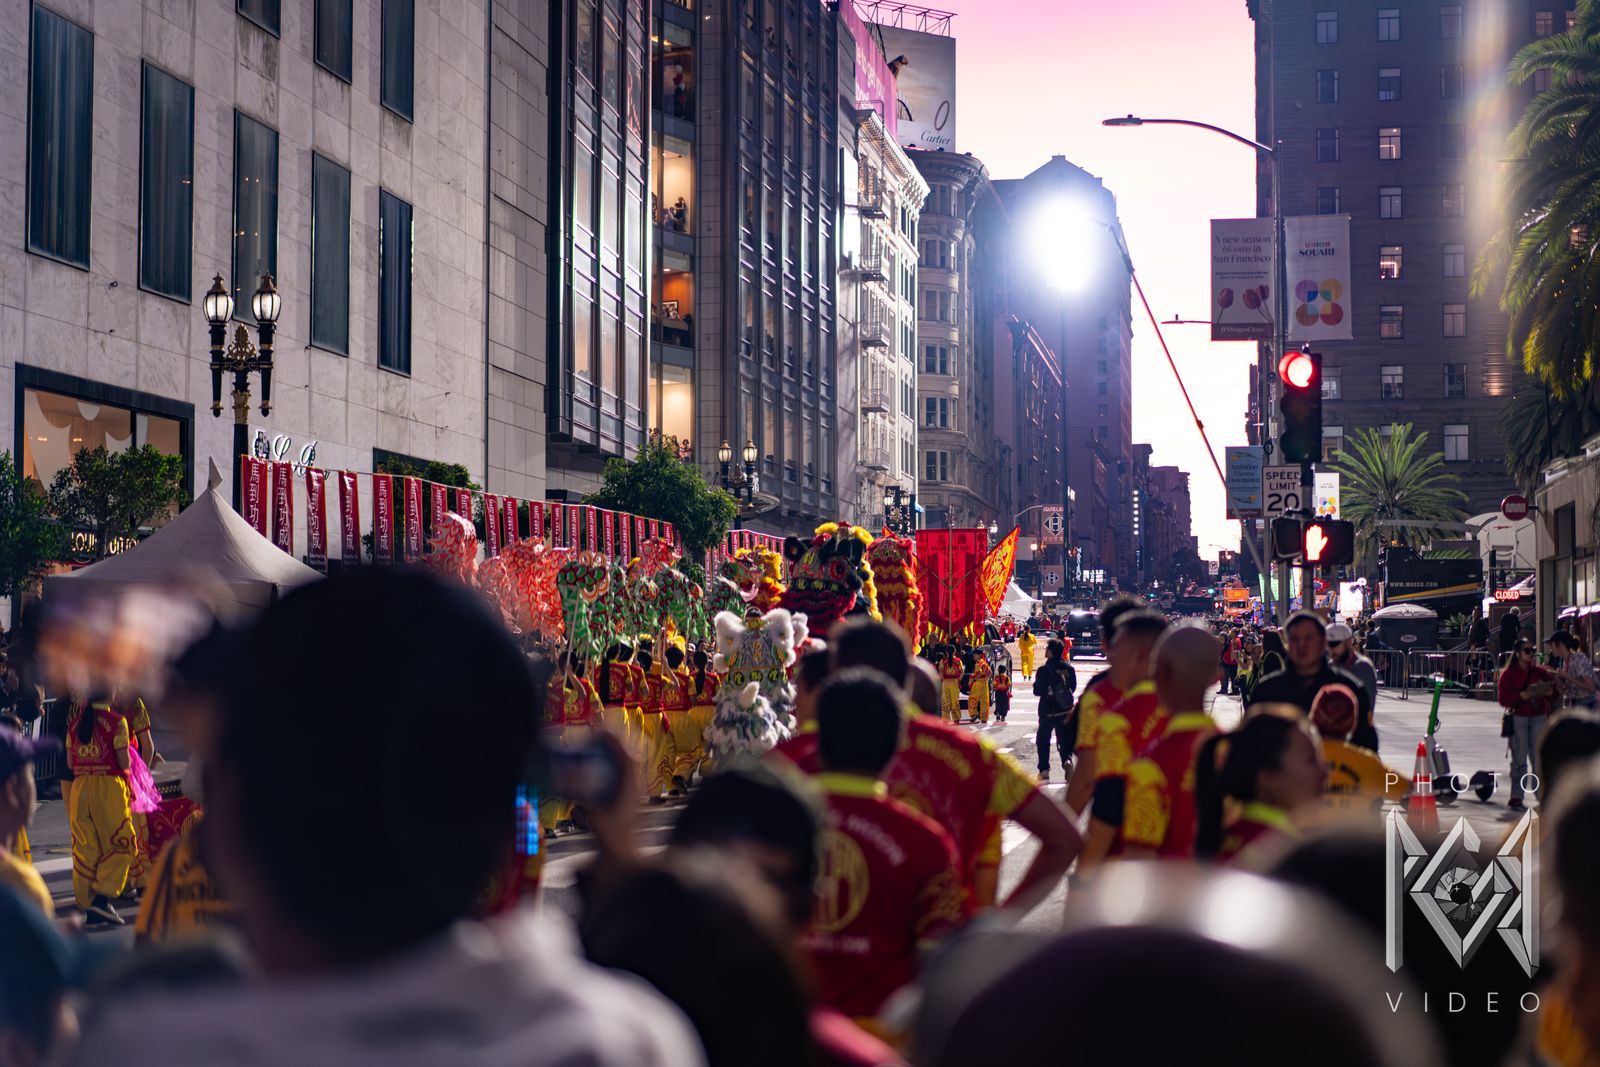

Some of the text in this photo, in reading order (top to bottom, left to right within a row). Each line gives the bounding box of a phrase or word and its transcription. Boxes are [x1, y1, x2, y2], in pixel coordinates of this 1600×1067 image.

[920, 130, 952, 145] Cartier
[1241, 236, 1271, 244] season
[1298, 248, 1336, 257] SQUARE
[1231, 254, 1271, 264] Francisco
[1269, 482, 1297, 491] LIMIT
[1267, 493, 1300, 512] 20
[1495, 590, 1520, 600] CLOSED
